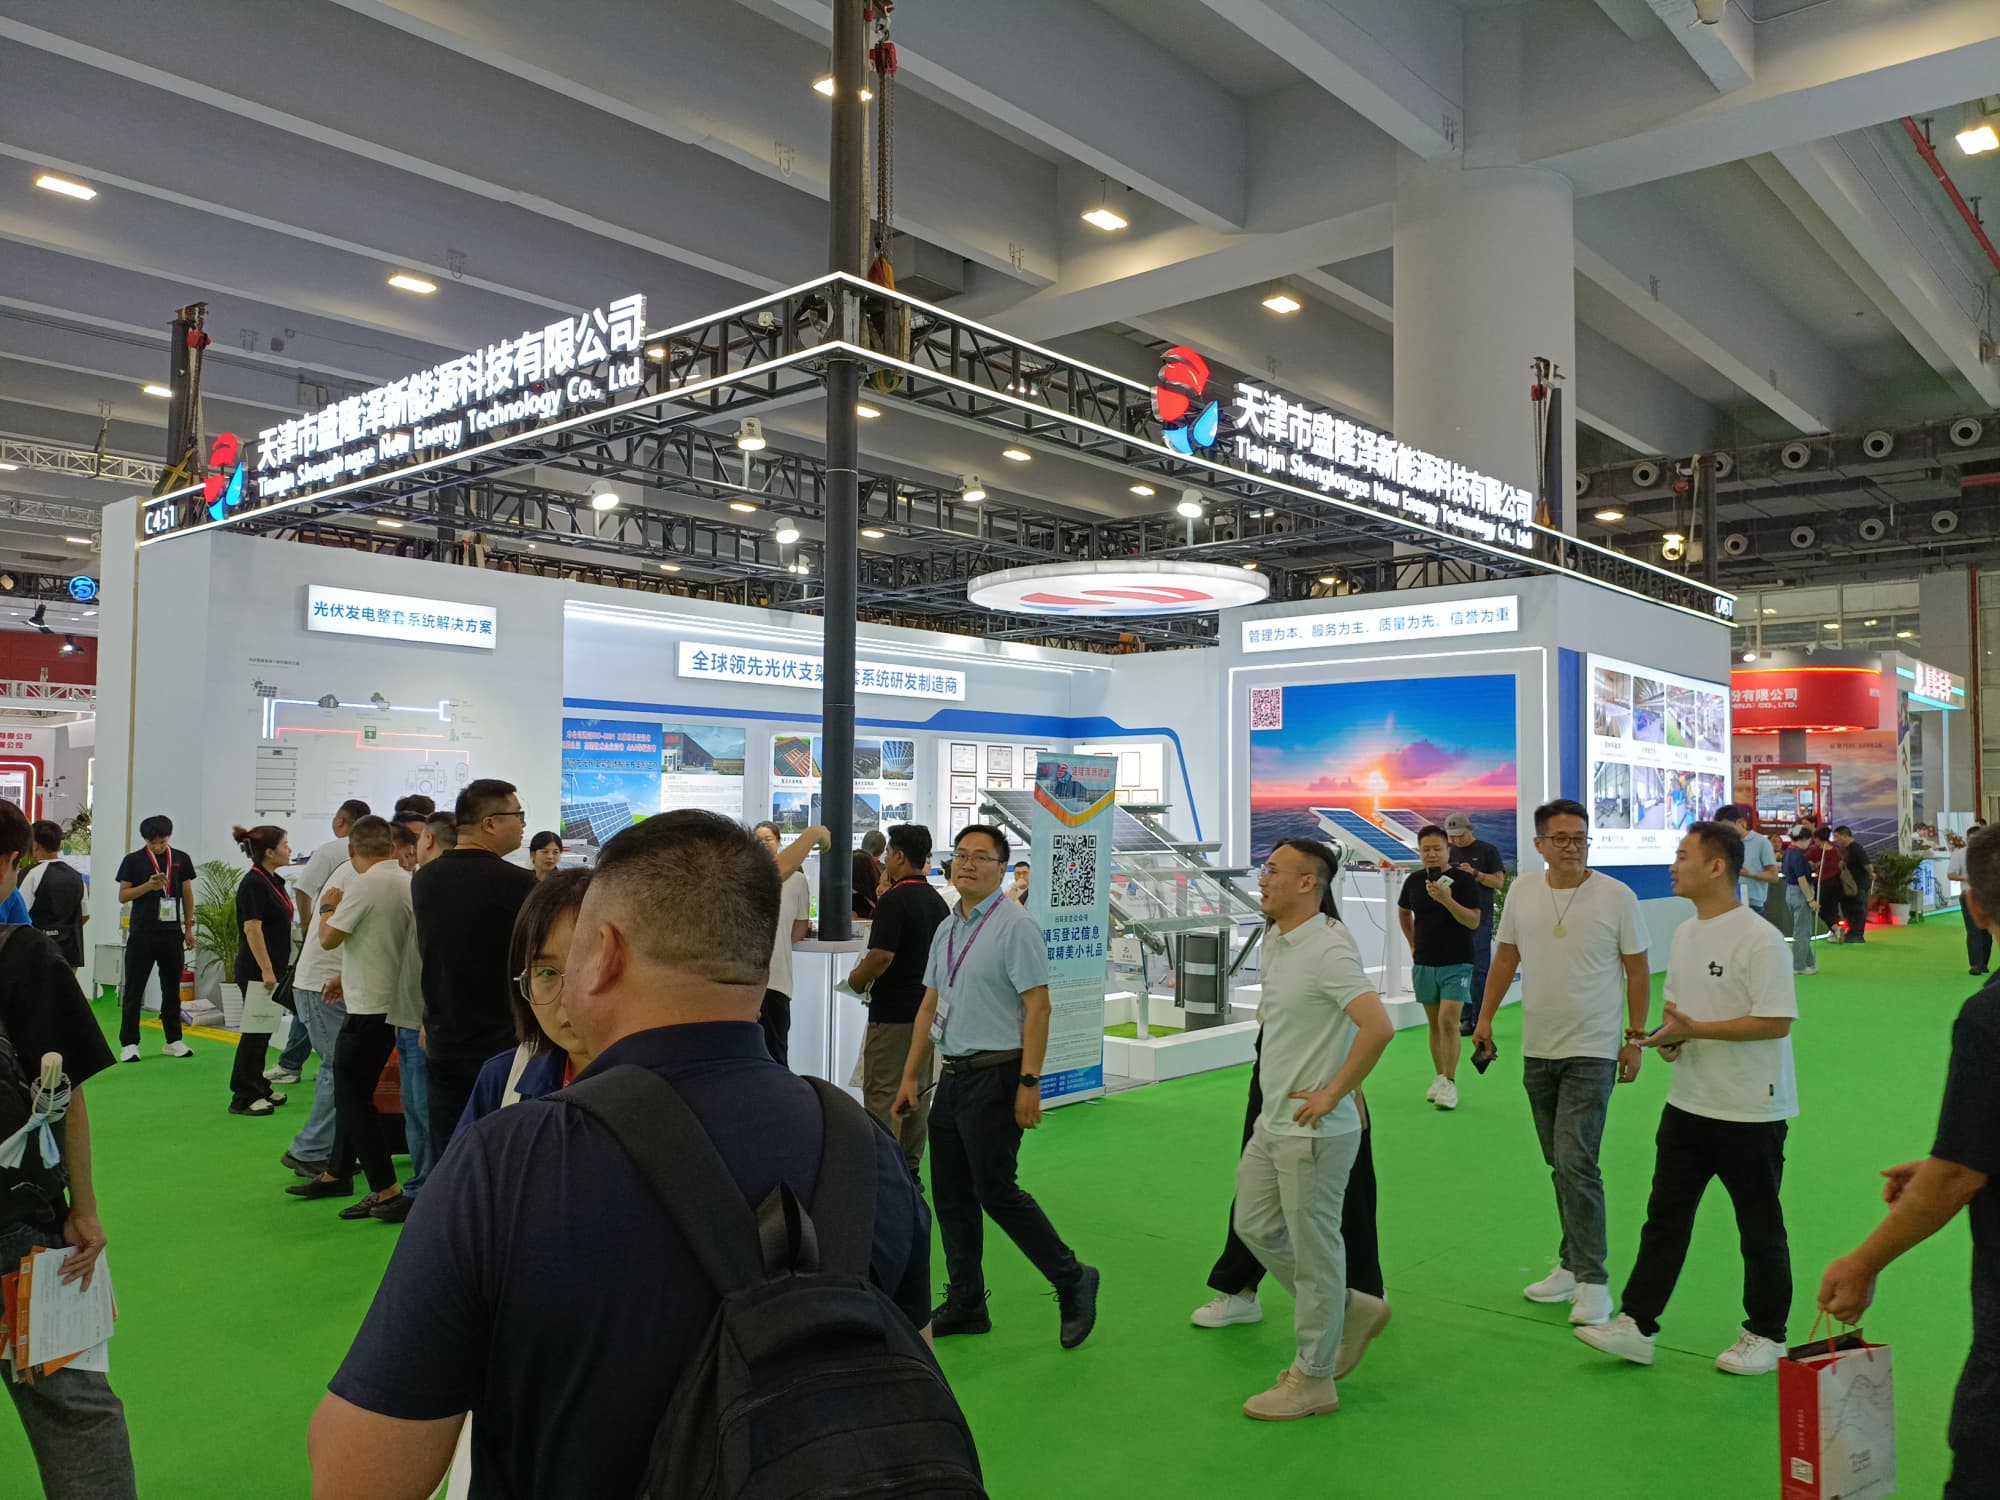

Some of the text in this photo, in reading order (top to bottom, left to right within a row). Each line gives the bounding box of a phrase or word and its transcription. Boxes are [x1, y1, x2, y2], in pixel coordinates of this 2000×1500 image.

[257, 293, 645, 472] 天津市盛隆泽新能源科技有限公司
[379, 432, 411, 460] New
[413, 420, 463, 449] Energy
[467, 389, 562, 433] Technology
[567, 376, 601, 402] Co.,
[608, 357, 641, 391] Ltd
[1234, 382, 1533, 525] 天津市盛隆泽新能源科技有限公司
[1236, 435, 1286, 474] Tianjin
[1289, 453, 1370, 500] Shenglongze
[1374, 480, 1399, 507] New
[145, 505, 176, 534] C451
[313, 600, 493, 635] 光伏发电整套系统解决方案
